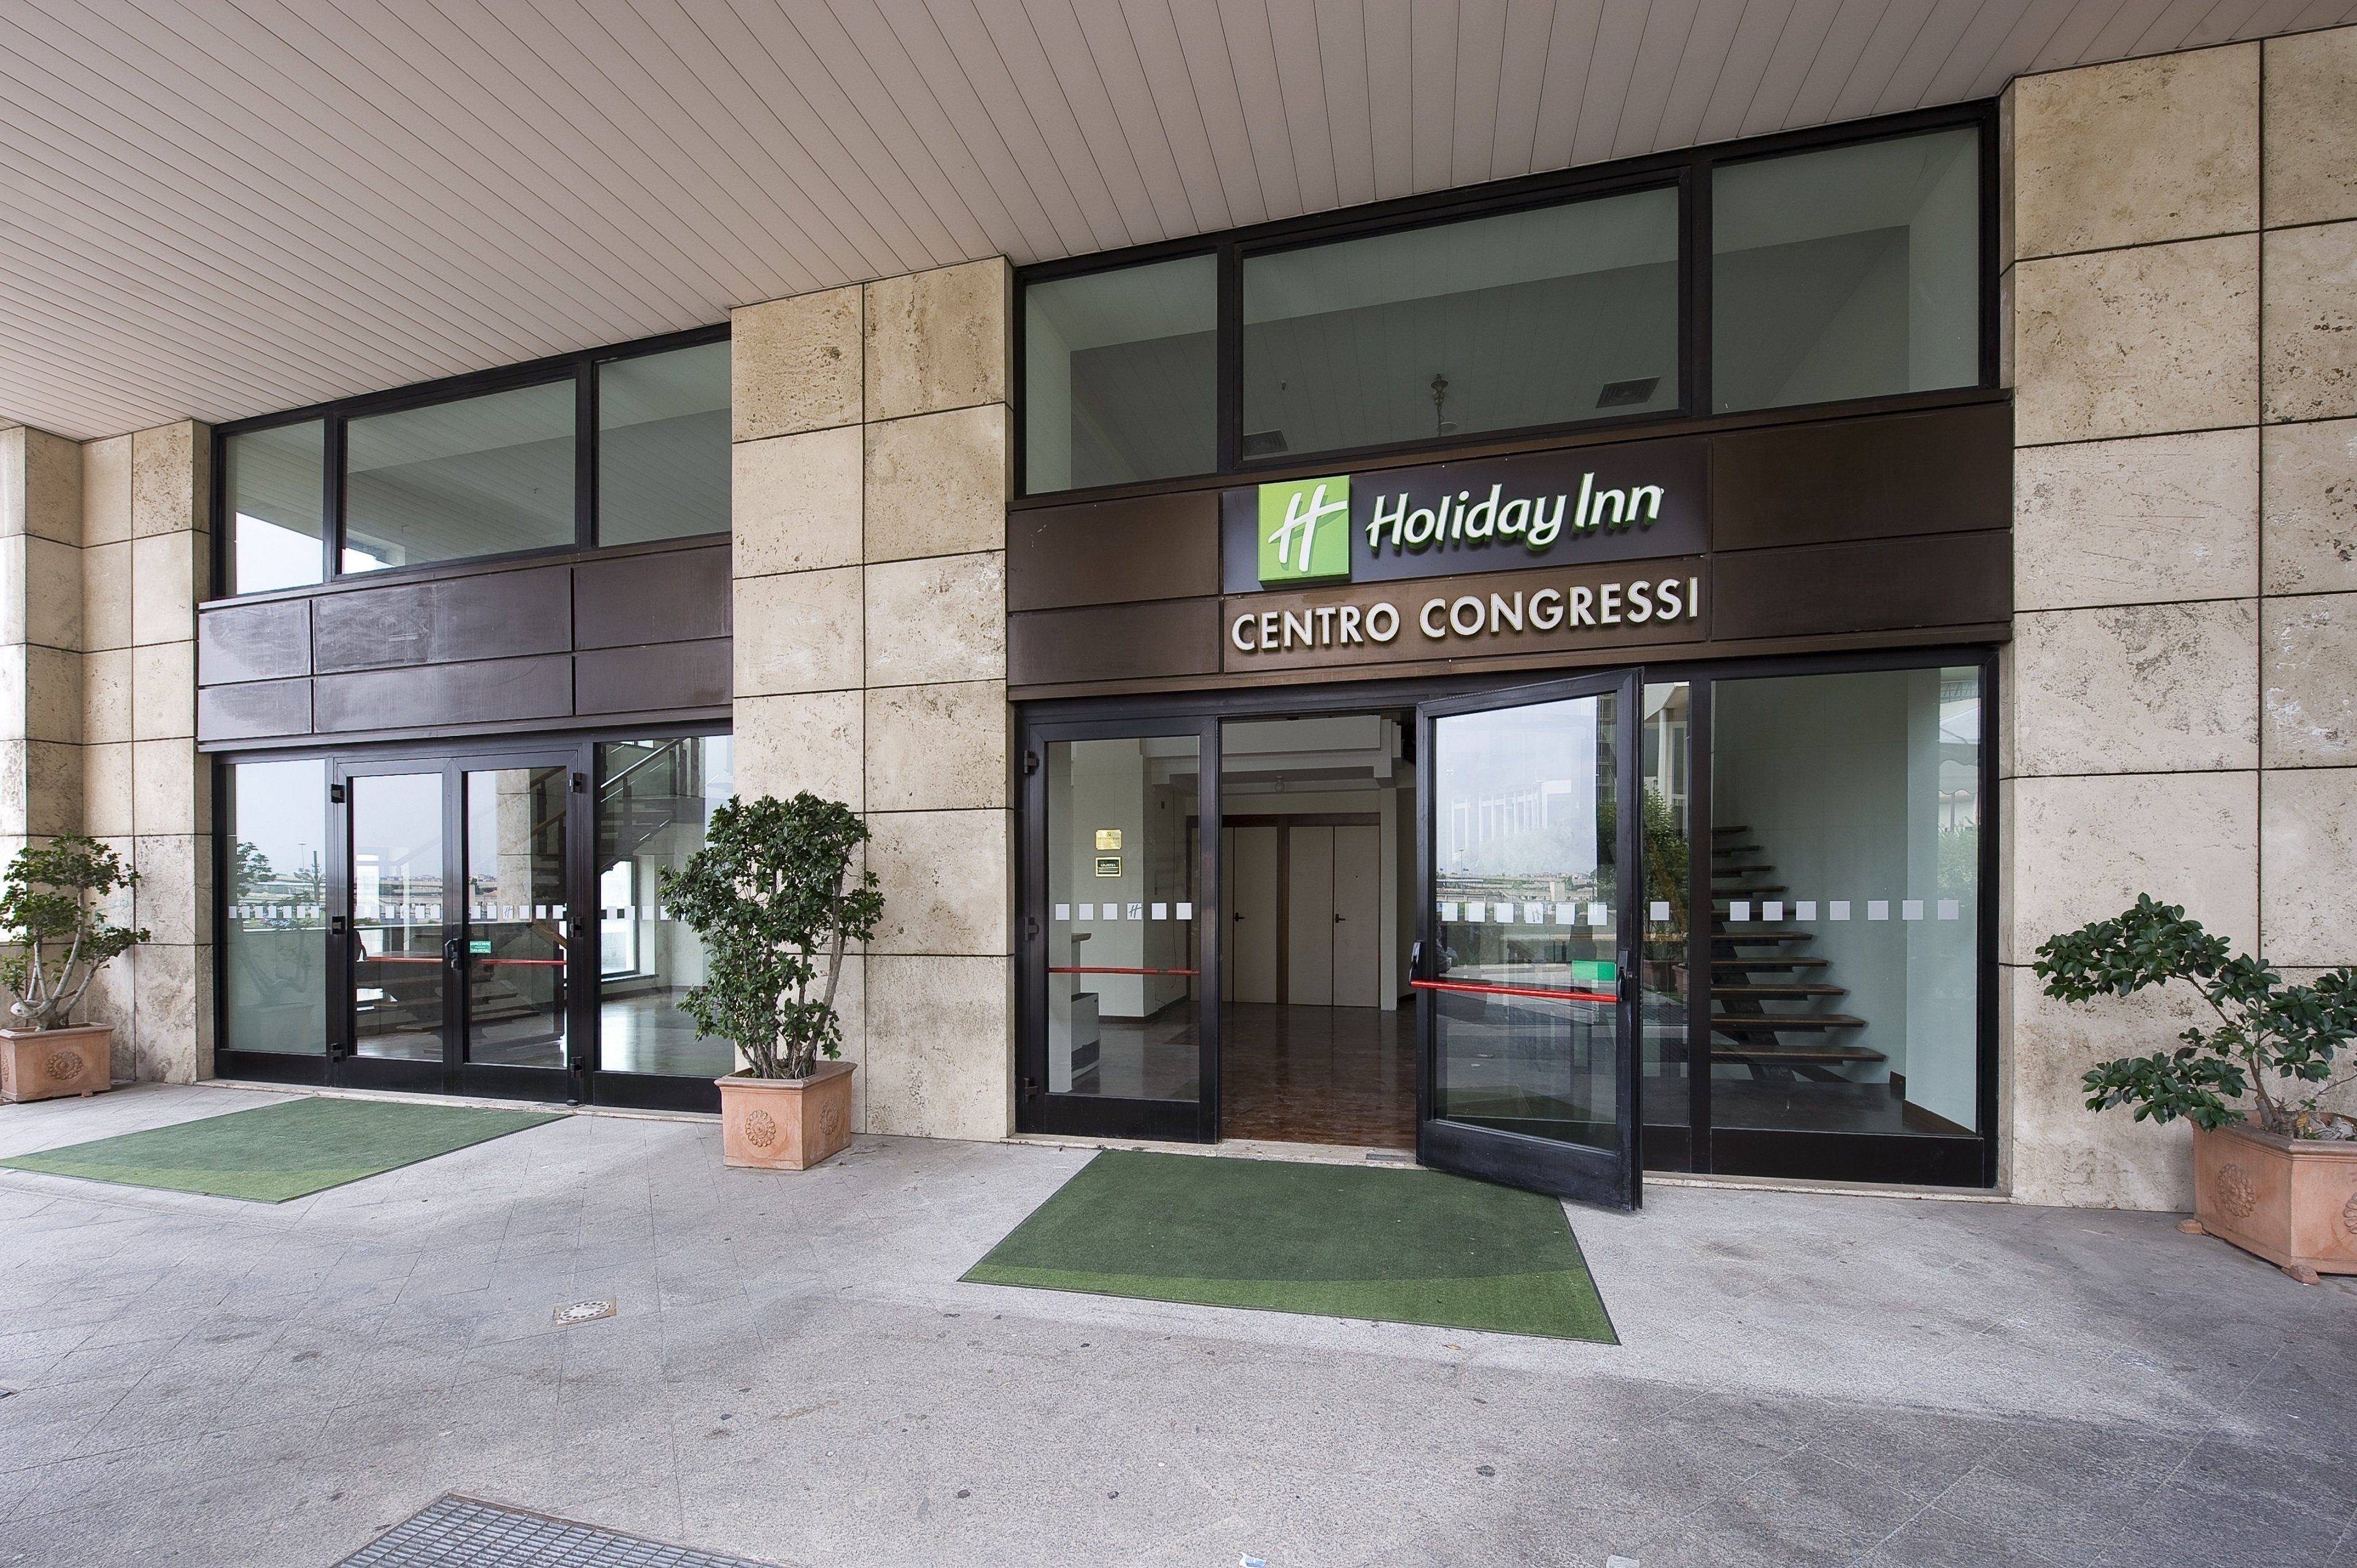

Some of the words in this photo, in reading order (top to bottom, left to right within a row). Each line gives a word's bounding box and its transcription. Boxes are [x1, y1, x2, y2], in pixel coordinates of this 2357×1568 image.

[1268, 484, 1348, 572] H
[1365, 483, 1567, 551] Holiday
[1573, 471, 1664, 534] Inn
[1231, 602, 1400, 651] CENTRO
[1419, 577, 1698, 638] CONGRESSI
